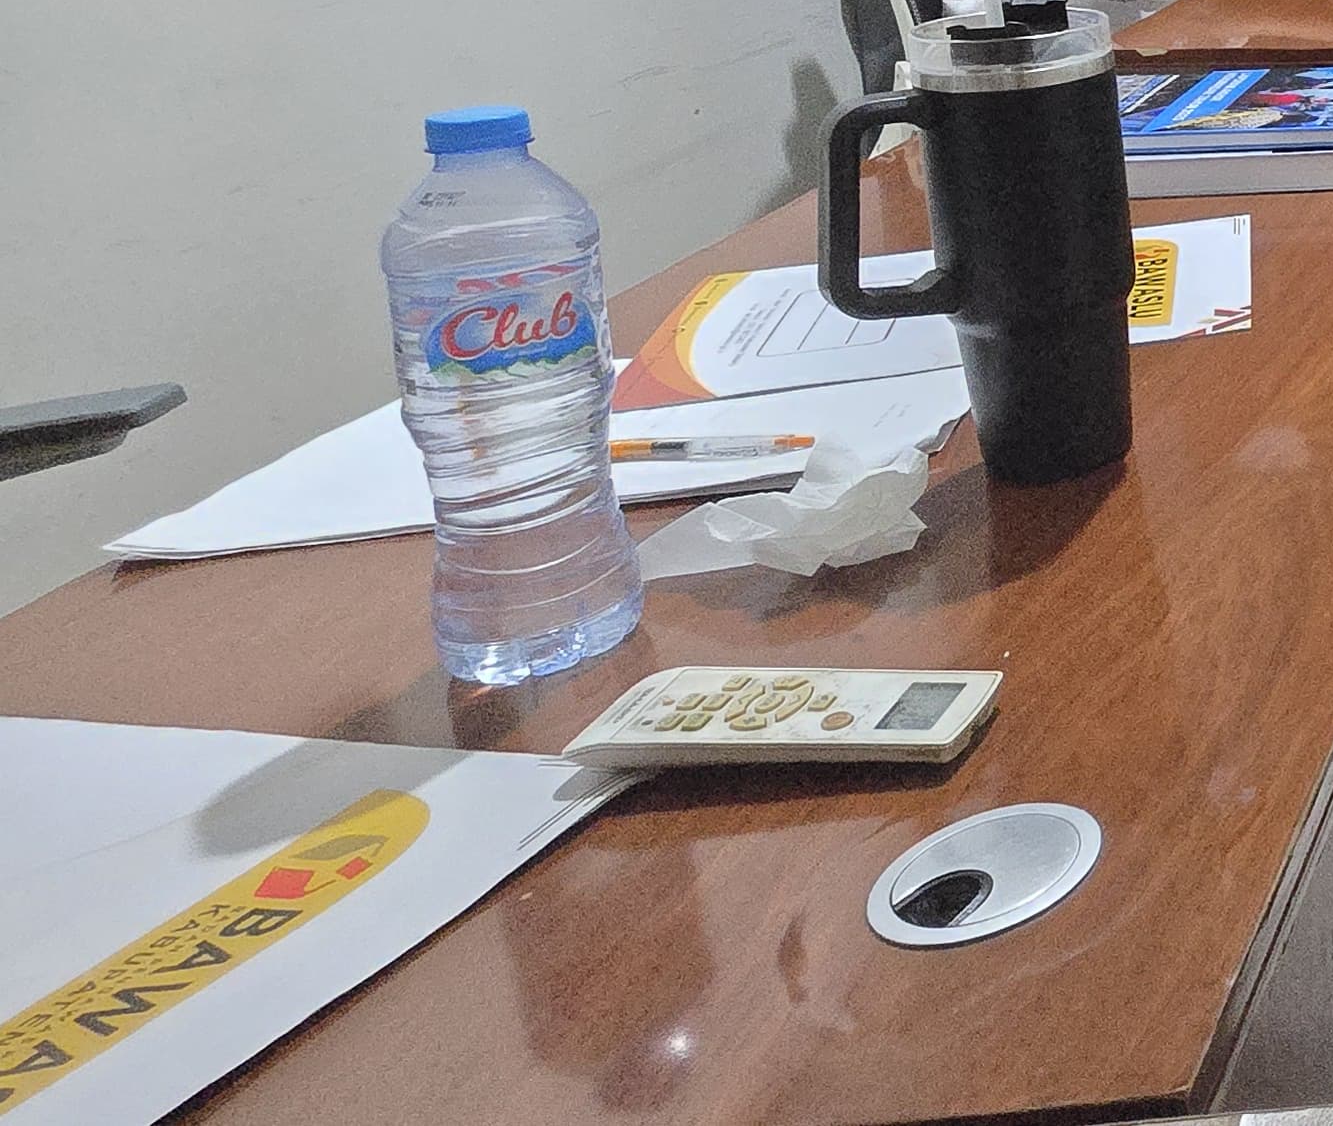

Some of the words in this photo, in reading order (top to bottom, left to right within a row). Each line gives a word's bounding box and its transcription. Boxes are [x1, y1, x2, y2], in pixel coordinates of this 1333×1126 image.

[1130, 256, 1168, 319] BAWASLU
[439, 290, 578, 360] Club
[0, 908, 303, 1104] BAWA
